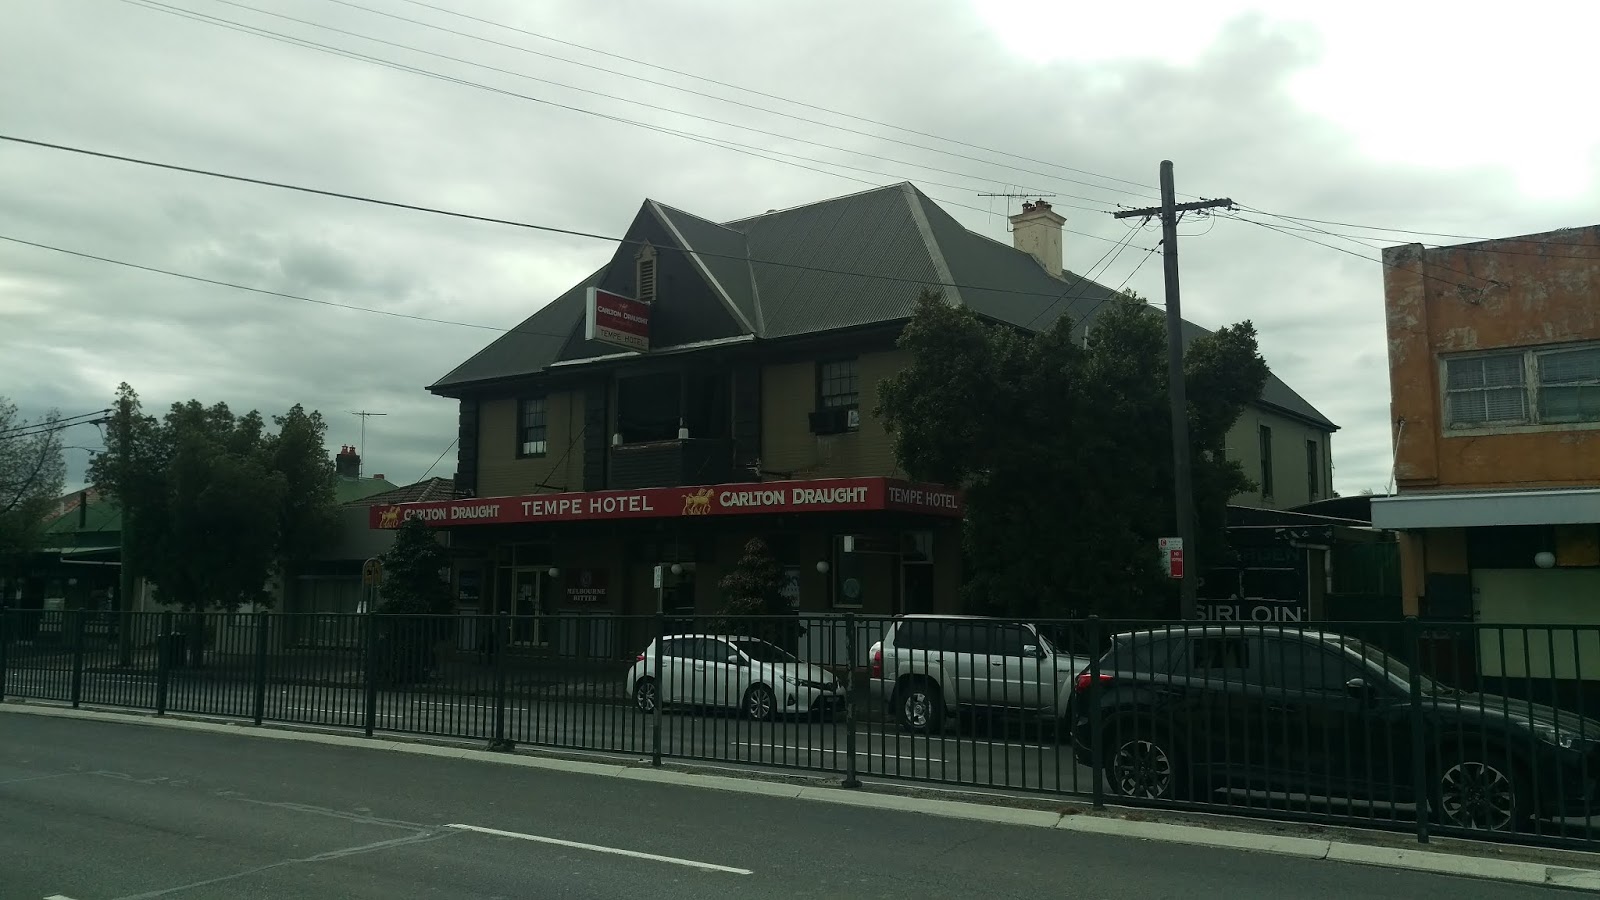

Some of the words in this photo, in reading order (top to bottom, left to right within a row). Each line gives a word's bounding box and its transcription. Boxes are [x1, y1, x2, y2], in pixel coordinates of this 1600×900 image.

[597, 305, 622, 318] CARLTON
[623, 312, 649, 325] DRAUGHT
[600, 329, 622, 341] TEMPE
[624, 335, 646, 346] HOTEL
[521, 499, 583, 516] TEMPE
[589, 495, 654, 514] HOTEL
[719, 489, 785, 507] CARLTON
[792, 486, 868, 505] DRAUGHT
[888, 487, 923, 505] TEMPE
[925, 492, 958, 509] HOTEL
[450, 504, 500, 519] DRAUGHT
